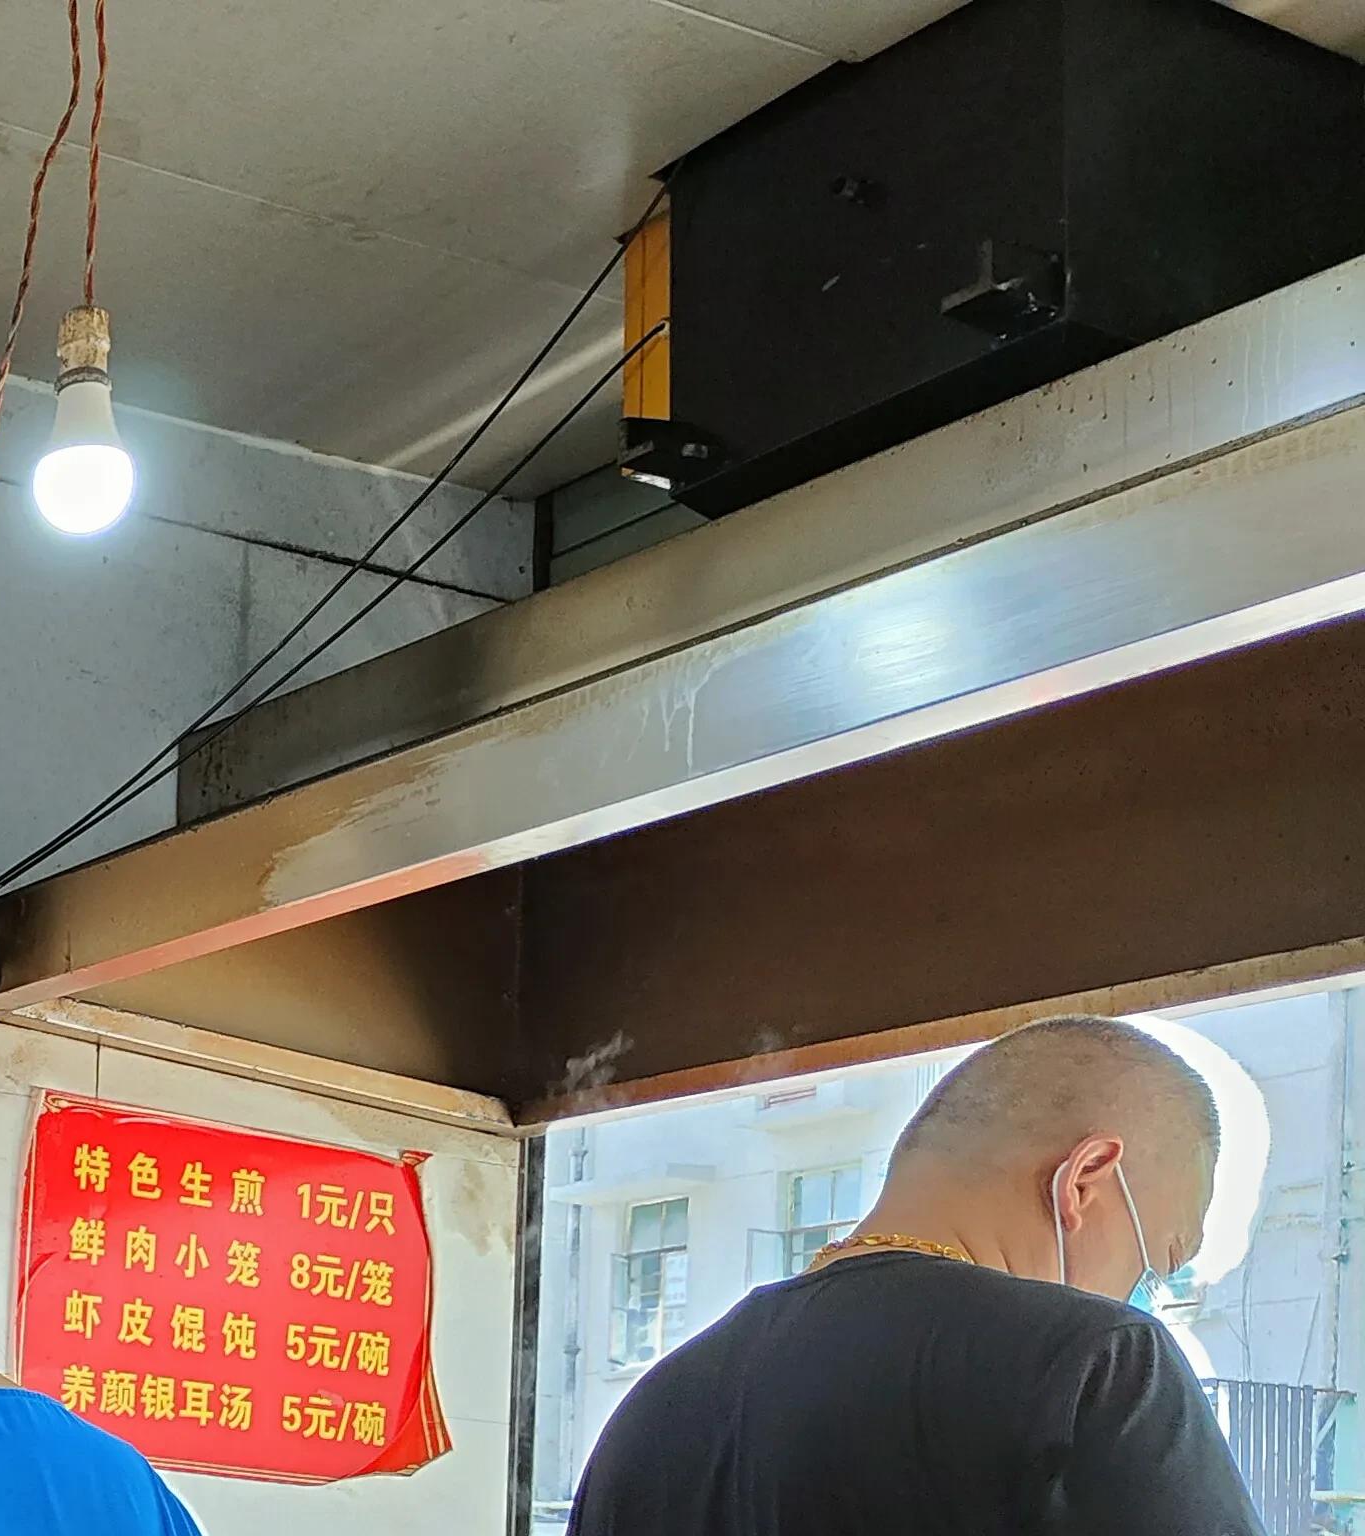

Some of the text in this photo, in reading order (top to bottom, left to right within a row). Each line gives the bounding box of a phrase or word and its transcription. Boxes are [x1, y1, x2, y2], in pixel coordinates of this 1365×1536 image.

[73, 1143, 396, 1236] 特色生煎 1元/只
[68, 1216, 395, 1307] 鲜肉小笼 8元/笼
[63, 1290, 391, 1377] 虾皮馄饨 5元/碗
[60, 1365, 387, 1447] 养颜银耳汤 5元/碗
